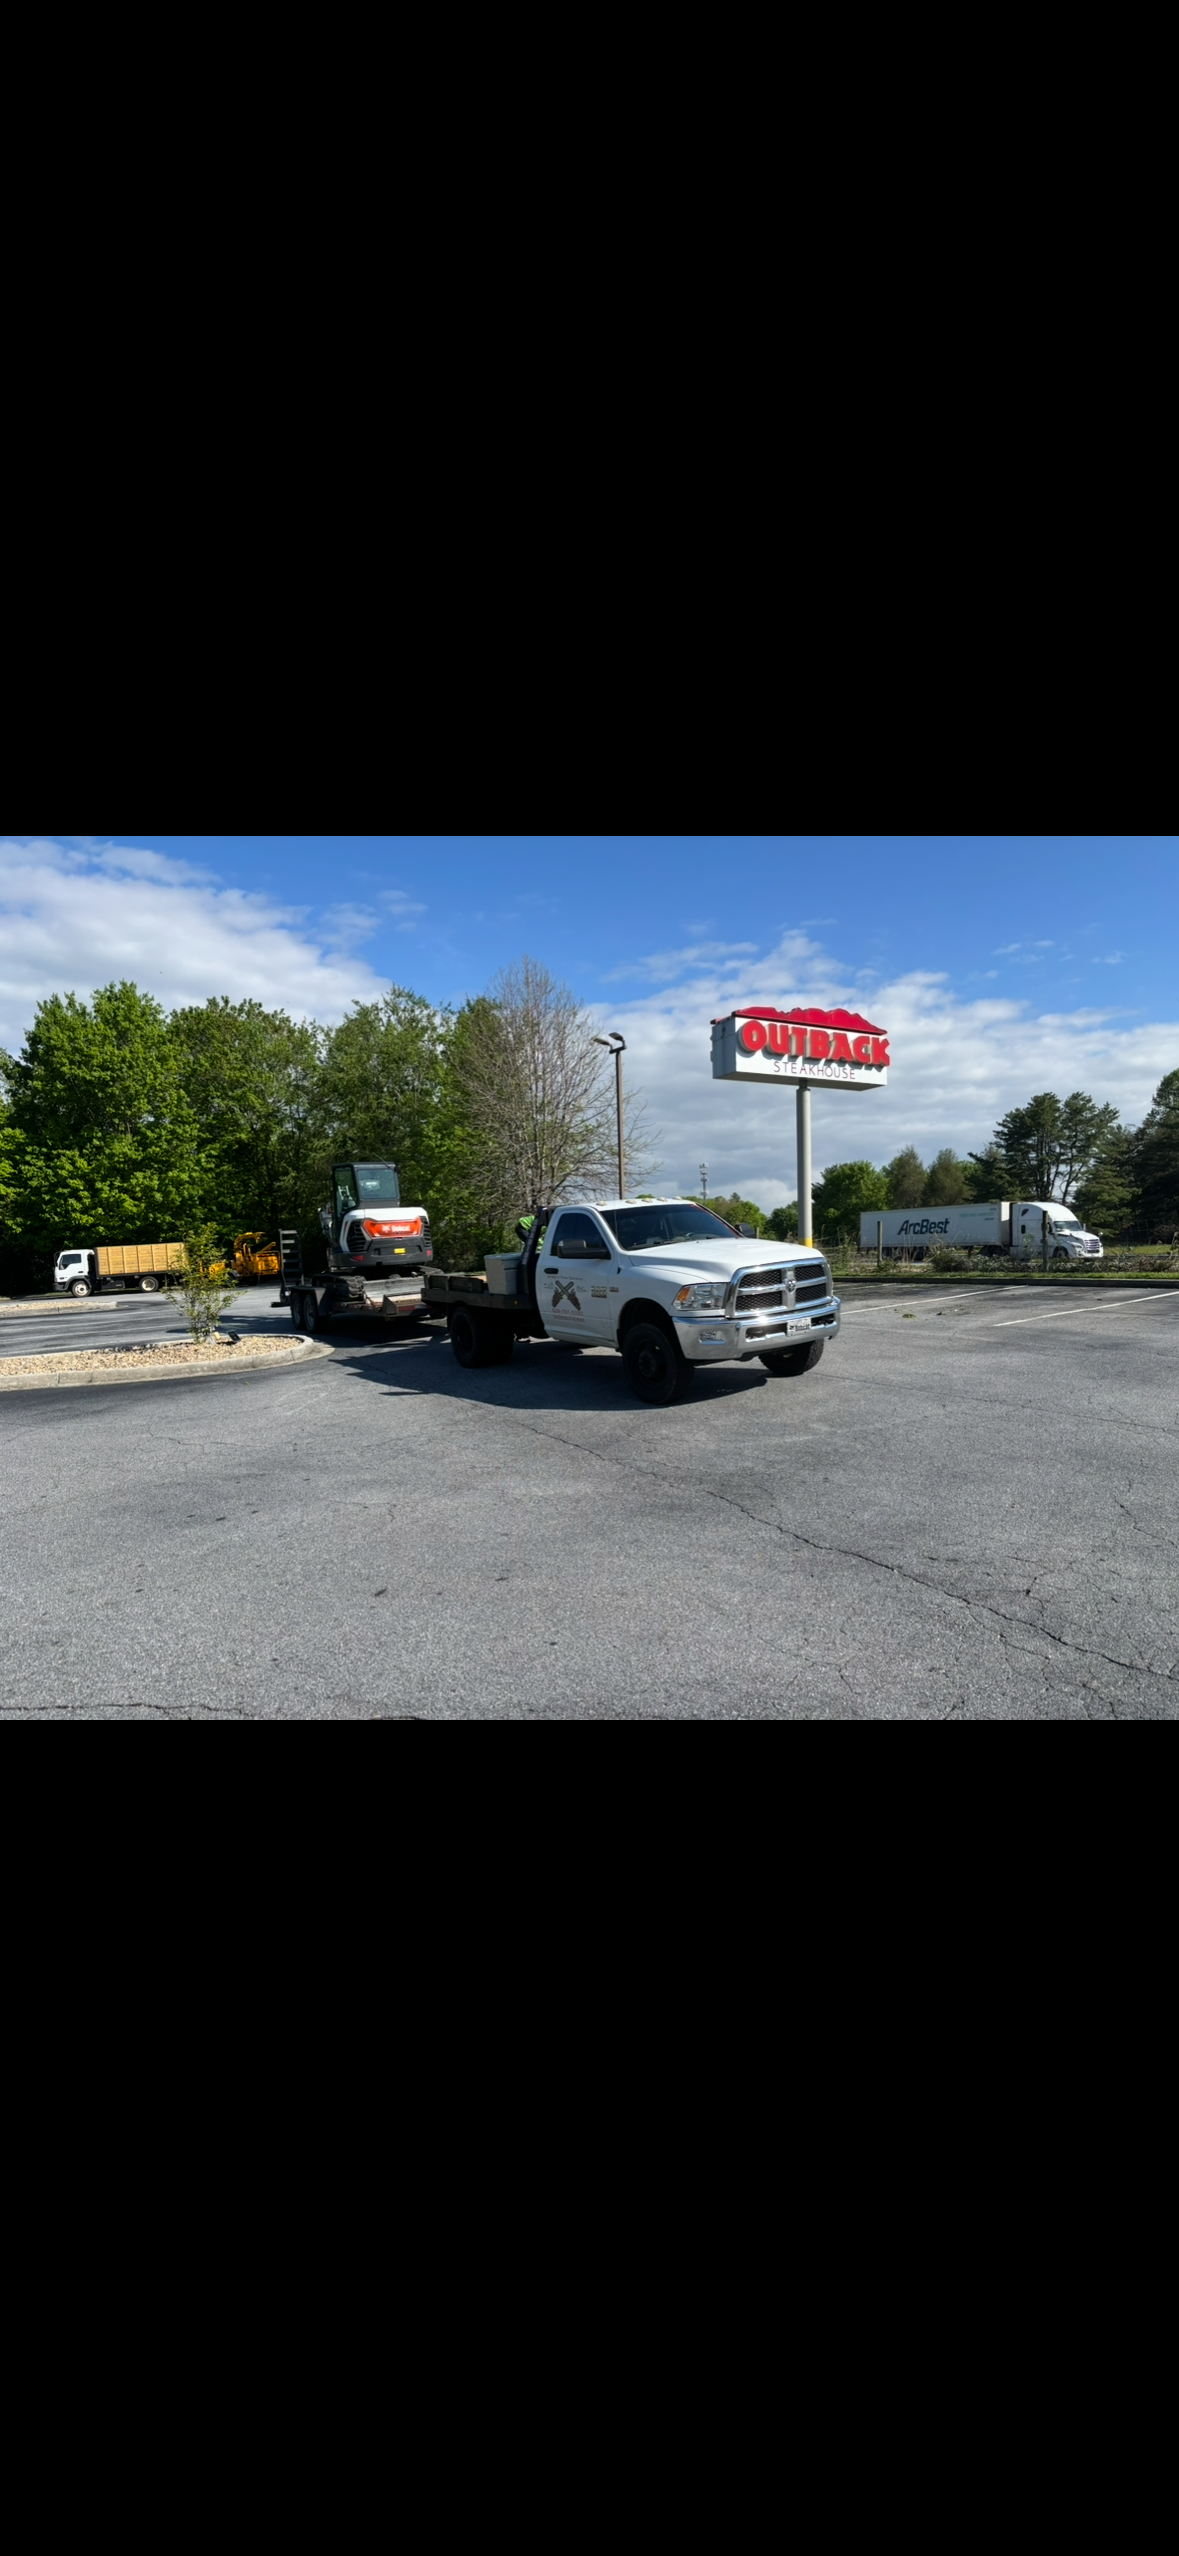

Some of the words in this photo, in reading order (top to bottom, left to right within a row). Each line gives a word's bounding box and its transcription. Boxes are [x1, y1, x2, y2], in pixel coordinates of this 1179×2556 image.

[739, 1020, 890, 1067] OUTBACK
[773, 1060, 856, 1080] STEAKHOUSE
[897, 1217, 950, 1235] ArcBest
